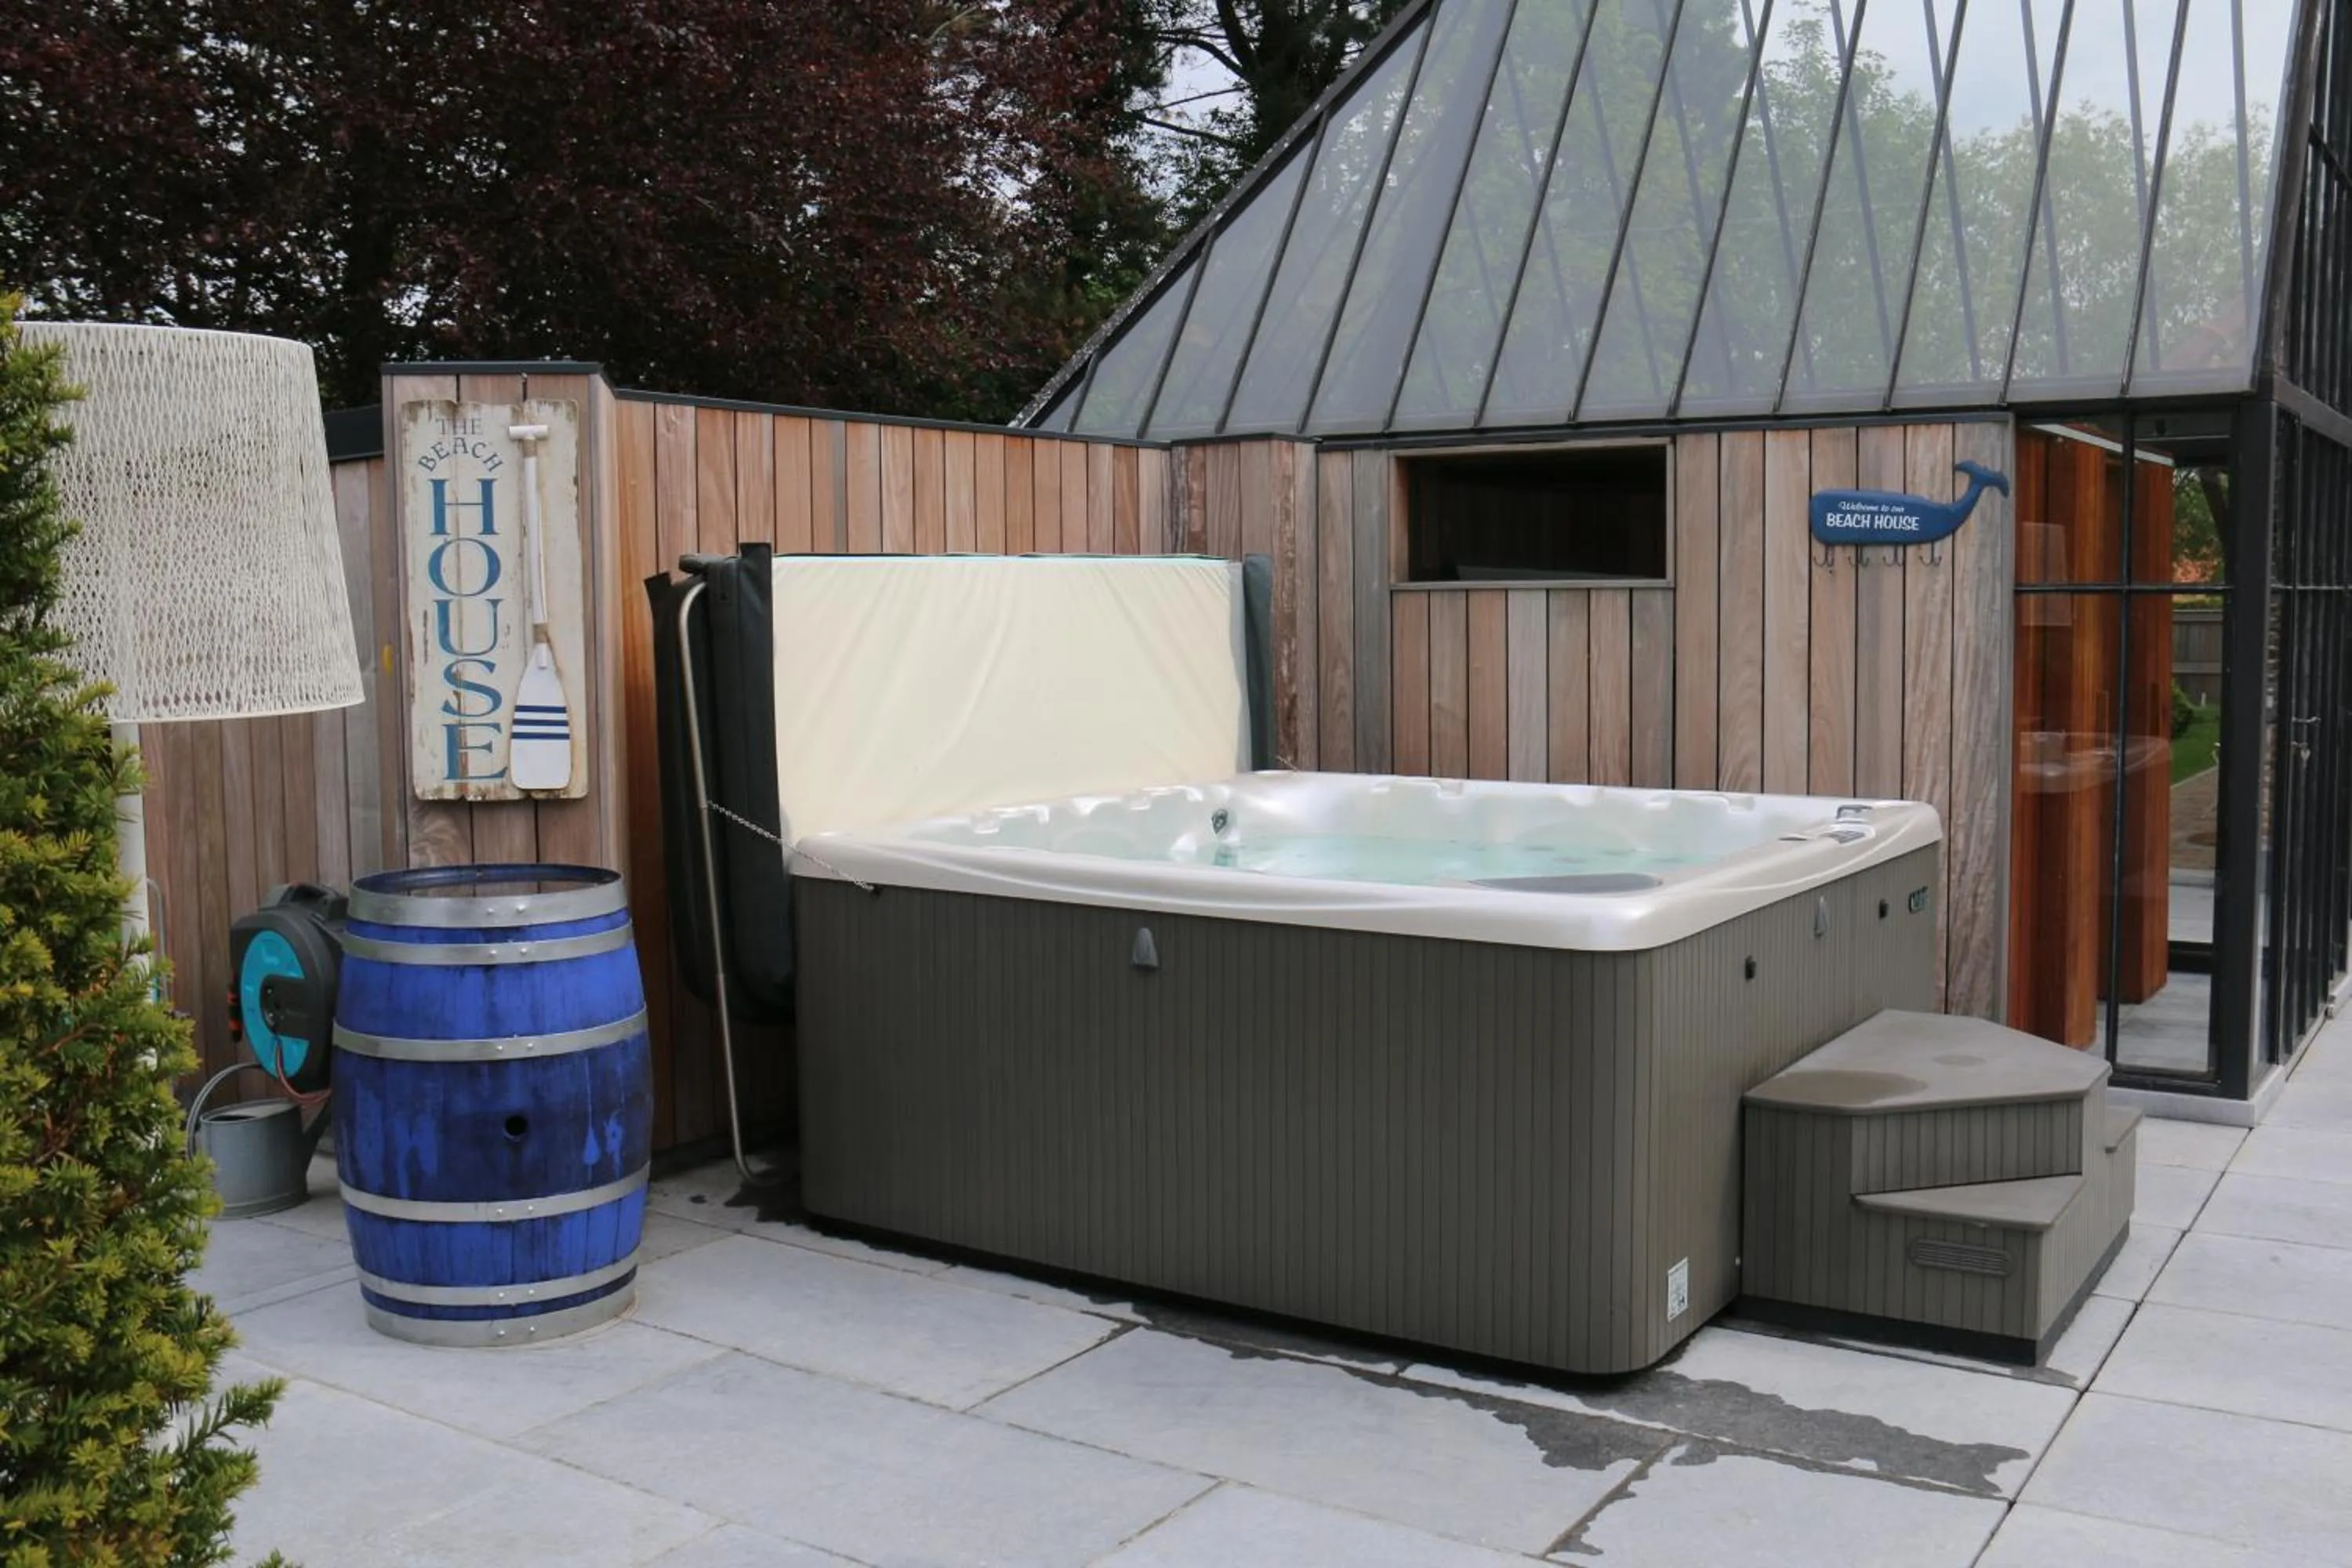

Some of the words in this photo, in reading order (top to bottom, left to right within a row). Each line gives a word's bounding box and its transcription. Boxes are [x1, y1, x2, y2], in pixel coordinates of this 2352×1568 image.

[435, 418, 483, 434] THE
[418, 437, 504, 472] BEACH
[1838, 501, 1878, 511] Welcome
[1826, 513, 1871, 528] BEACH
[1874, 515, 1920, 531] HOUSE
[427, 478, 507, 780] HOUSE
